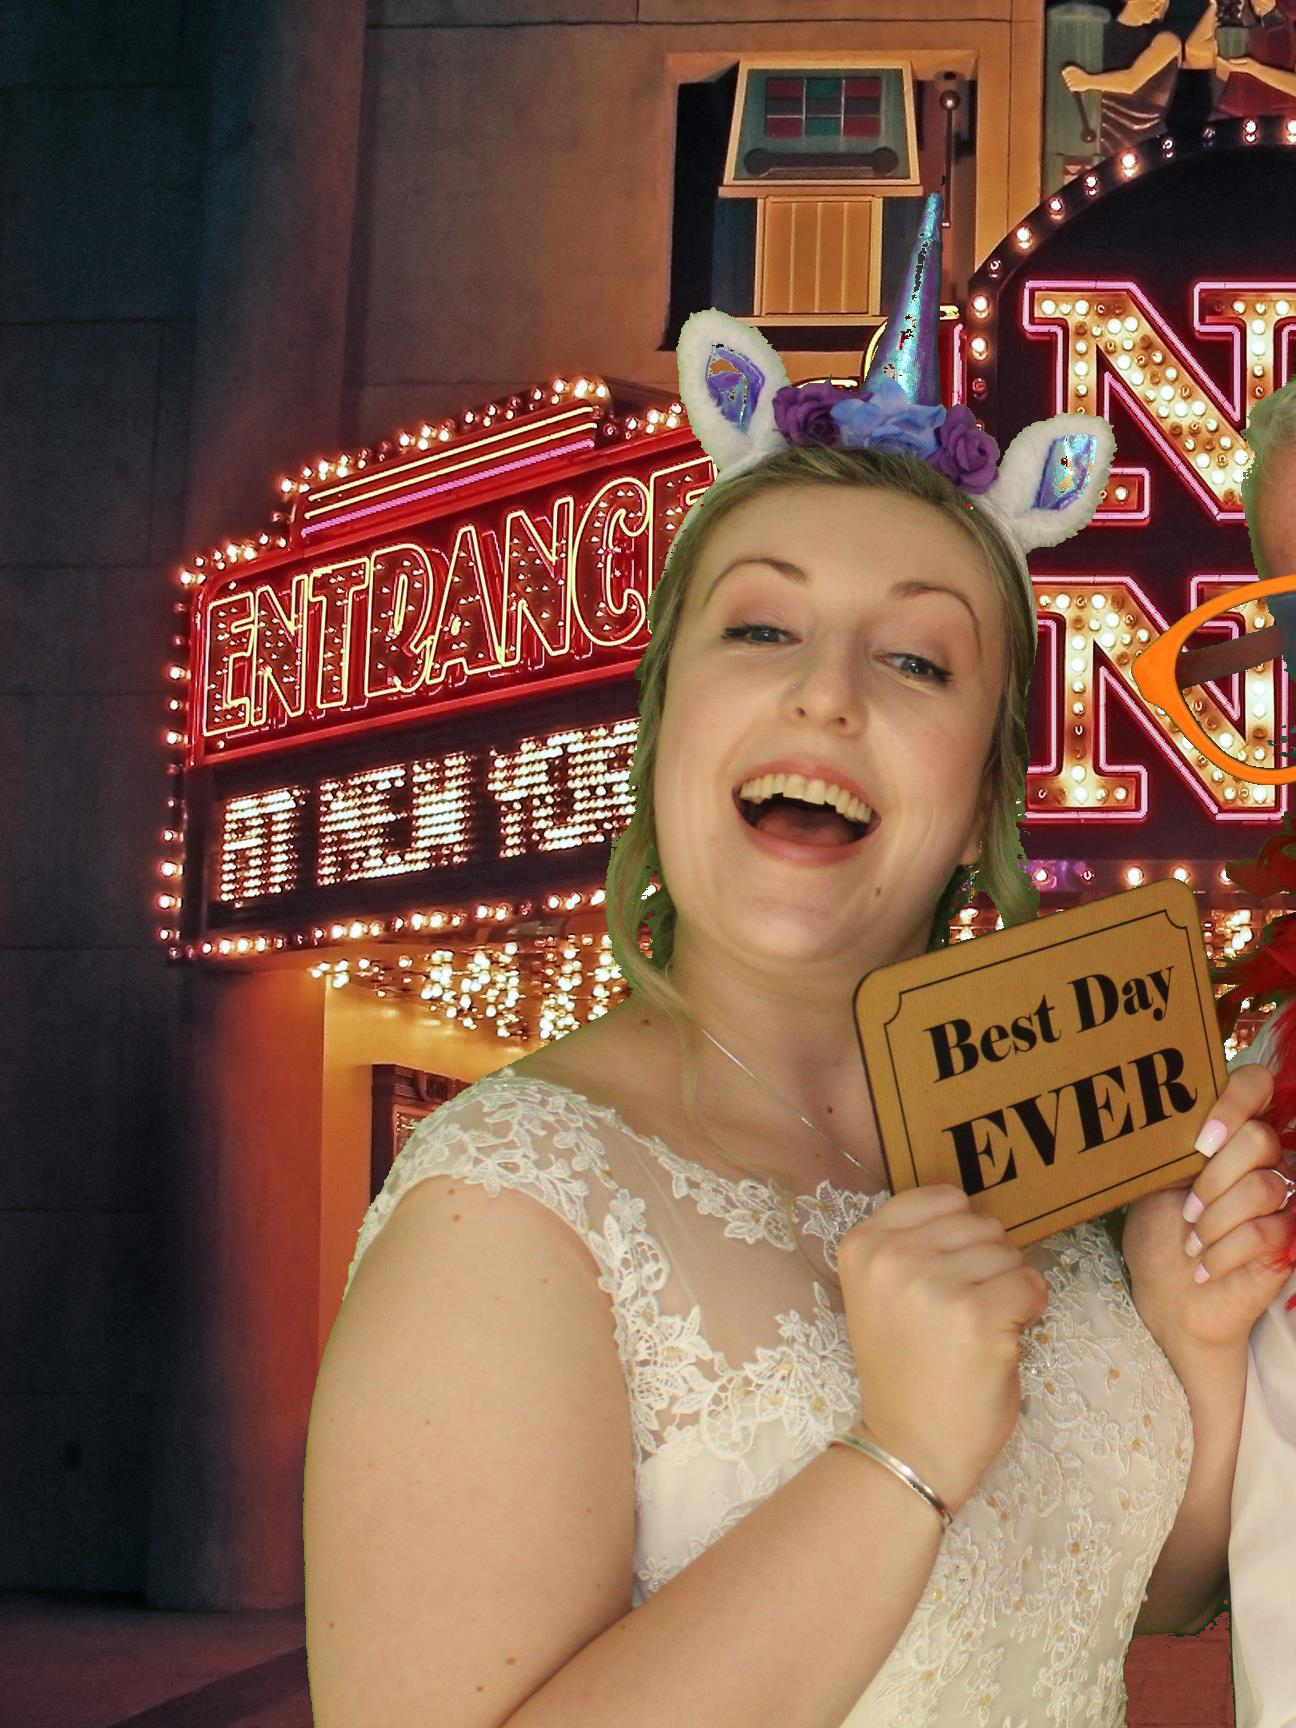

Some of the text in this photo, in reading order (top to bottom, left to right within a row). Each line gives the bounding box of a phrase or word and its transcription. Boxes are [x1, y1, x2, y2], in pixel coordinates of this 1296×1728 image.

[922, 965, 1175, 1083] Best Day
[941, 1046, 1198, 1197] EVER
